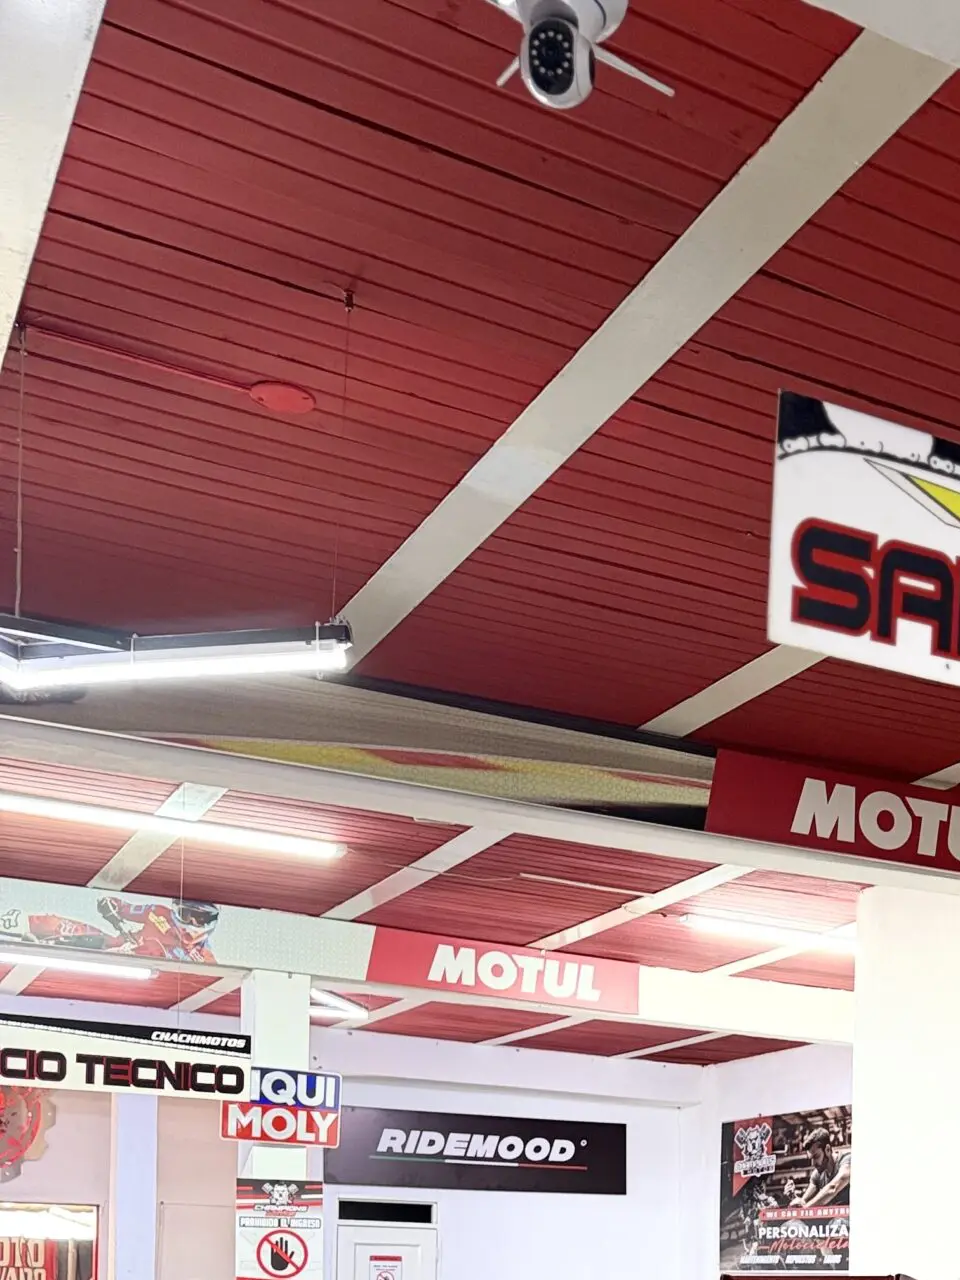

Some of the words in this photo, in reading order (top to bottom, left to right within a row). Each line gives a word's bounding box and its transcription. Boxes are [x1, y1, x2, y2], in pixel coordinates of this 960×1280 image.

[427, 943, 601, 1002] MOTUL
[151, 1030, 247, 1049] CHACHIMOTOS
[76, 1053, 245, 1095] TECNICO
[250, 1069, 336, 1108] IQUI
[227, 1103, 338, 1143] MOLY
[376, 1127, 576, 1162] RIDEMOOD
